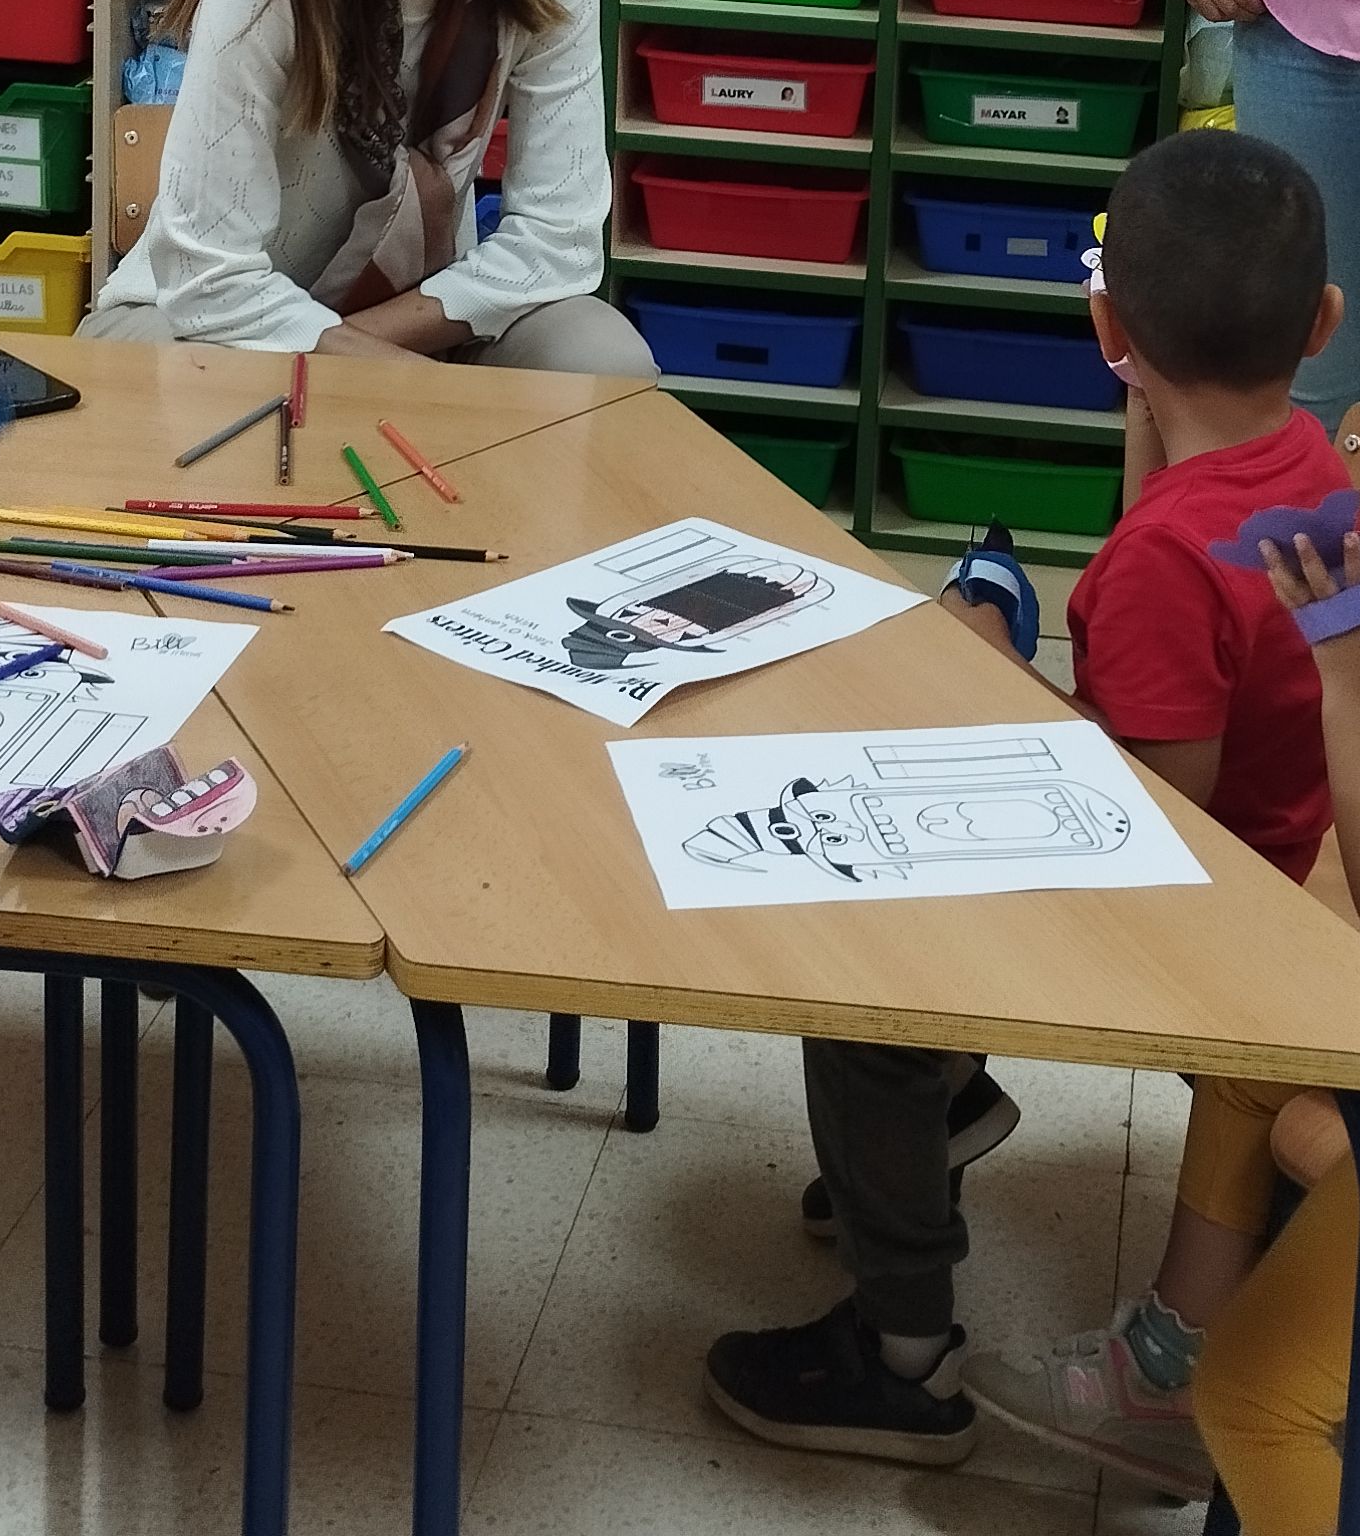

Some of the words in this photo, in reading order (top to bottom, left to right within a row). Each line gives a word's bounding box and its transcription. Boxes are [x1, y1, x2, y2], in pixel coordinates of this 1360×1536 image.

[710, 87, 755, 100] LAURY
[980, 108, 1027, 120] MAYAR
[426, 614, 512, 655] Critters
